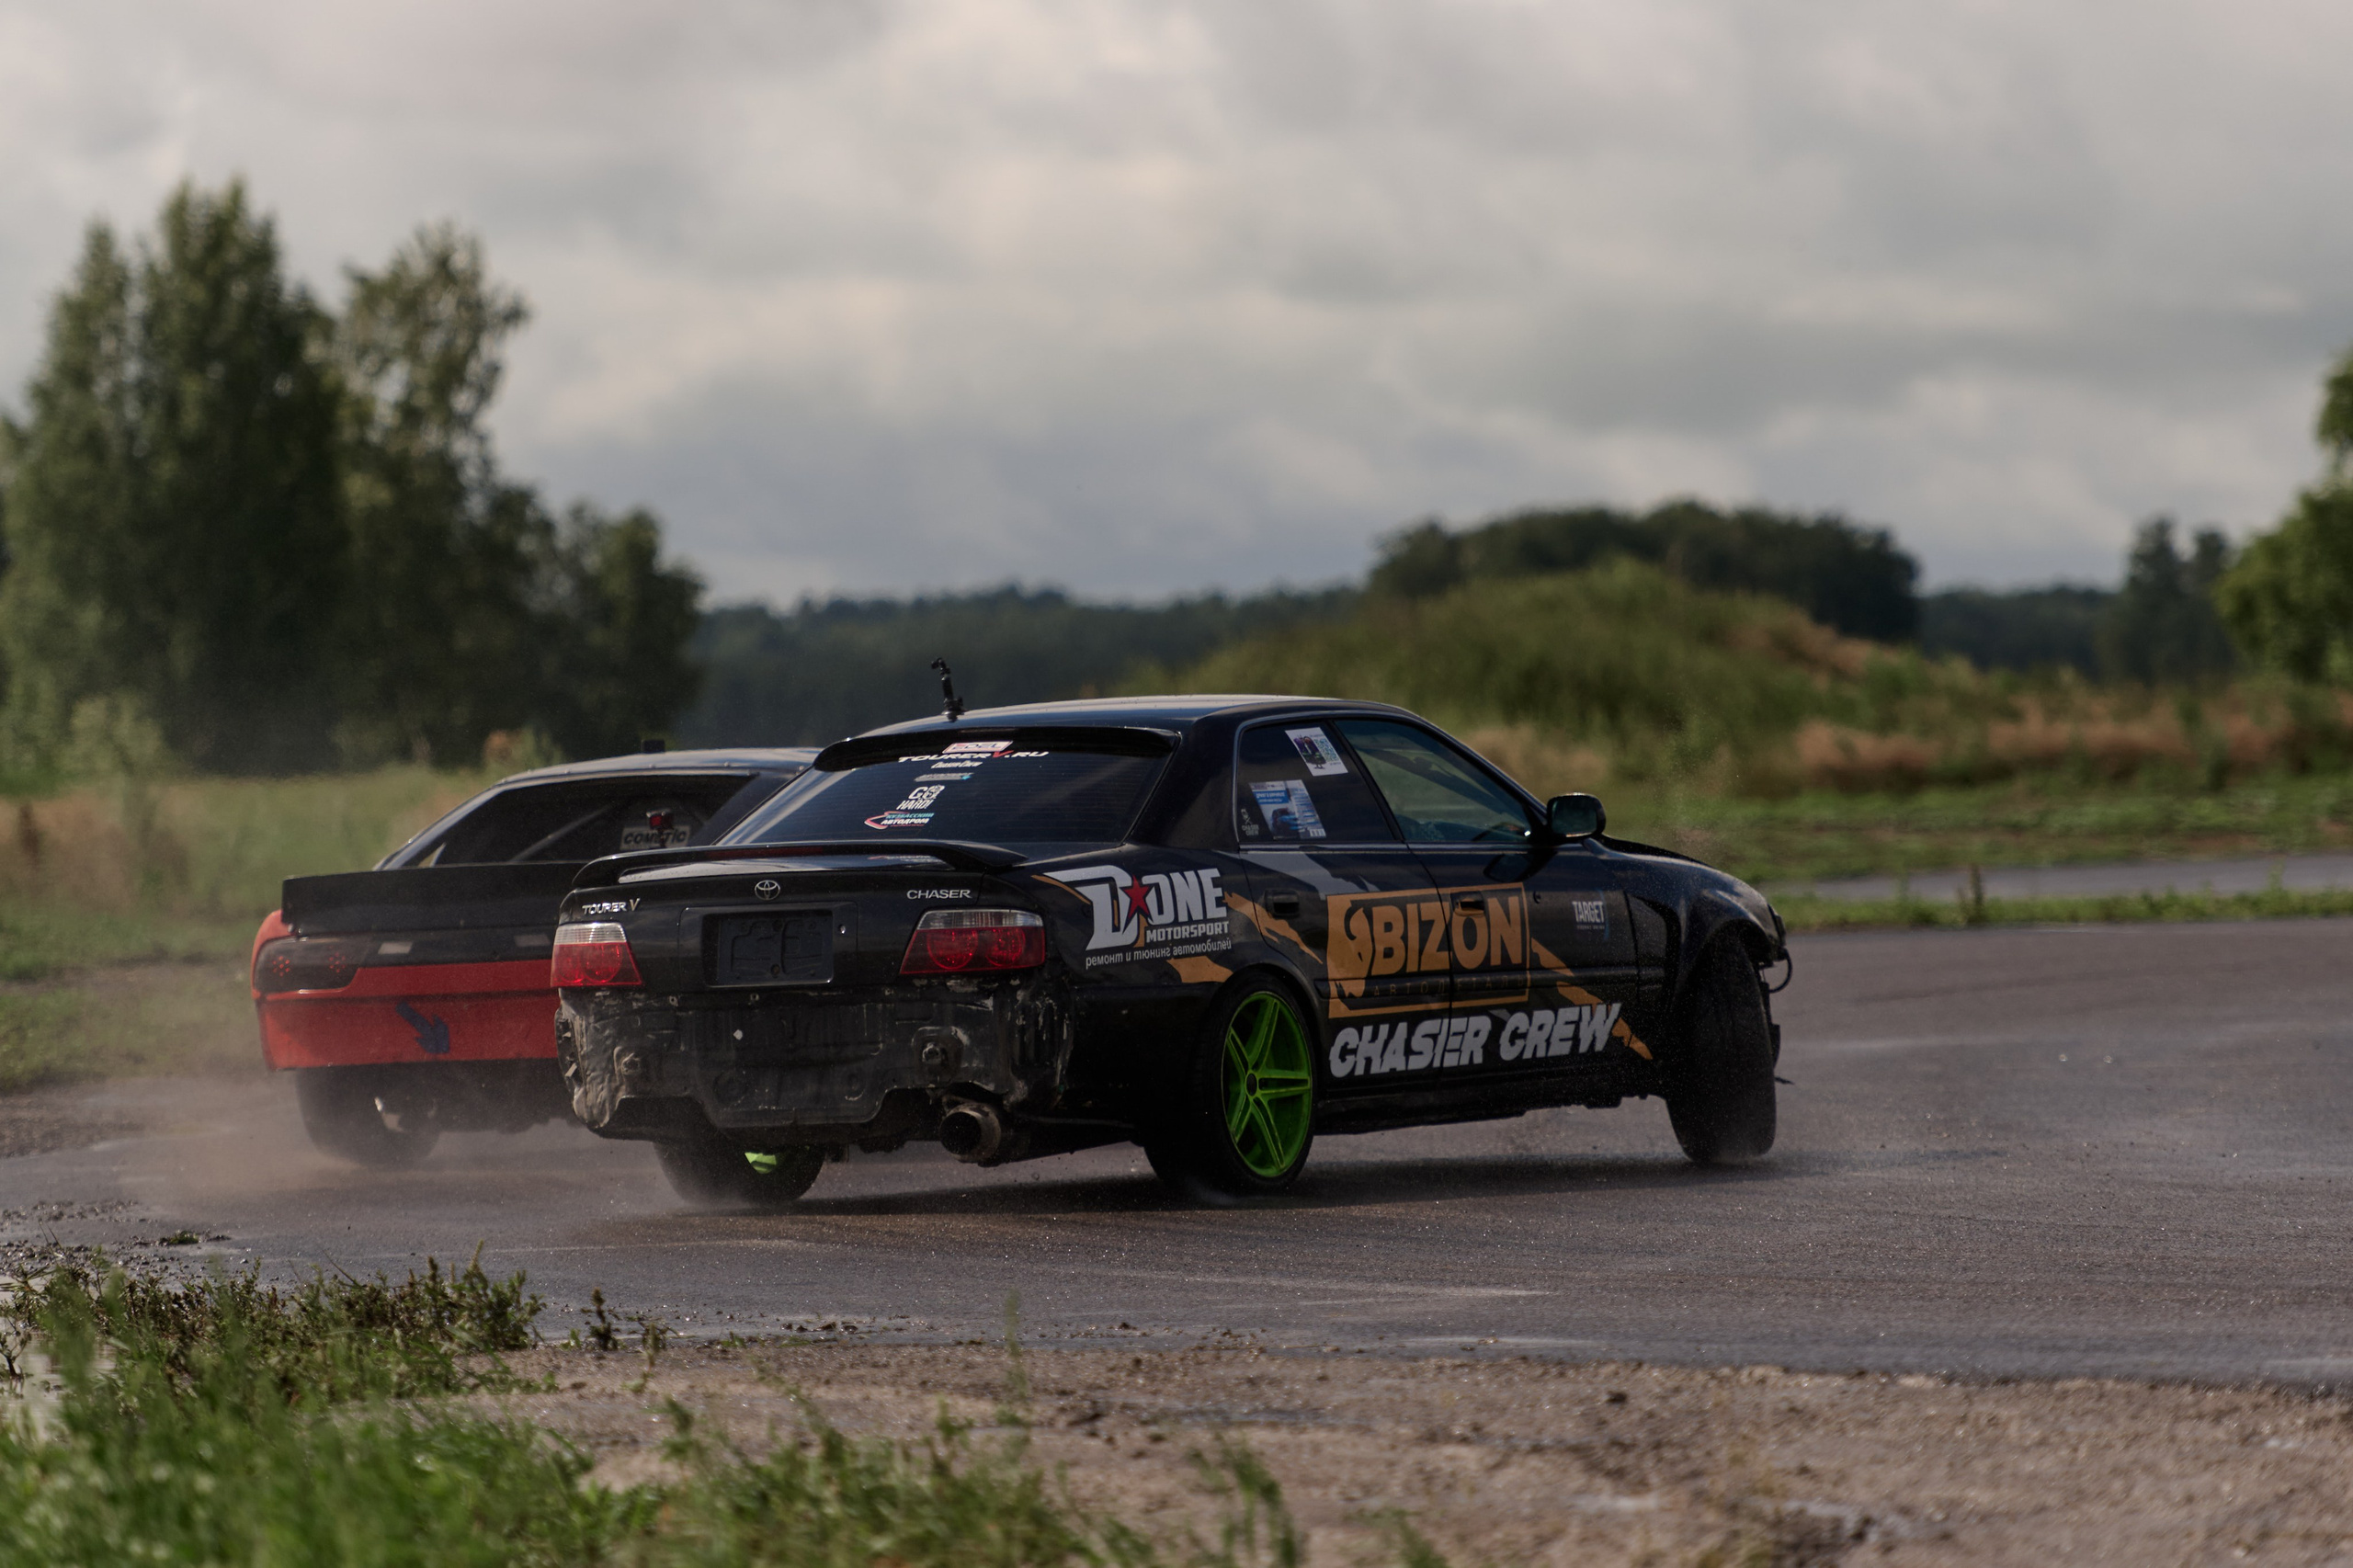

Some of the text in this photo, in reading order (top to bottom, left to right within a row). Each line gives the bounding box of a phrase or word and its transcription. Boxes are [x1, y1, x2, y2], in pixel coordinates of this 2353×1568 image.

[905, 888, 972, 900] CHASER
[582, 897, 642, 915] TOURER V
[1572, 901, 1605, 924] TARGET
[1146, 921, 1230, 943] MOTORSPORT
[1370, 895, 1523, 976] BIZON
[1086, 937, 1233, 970] ремонт и тюнинг автомобилей
[1329, 1003, 1622, 1079] CHASER CREW
